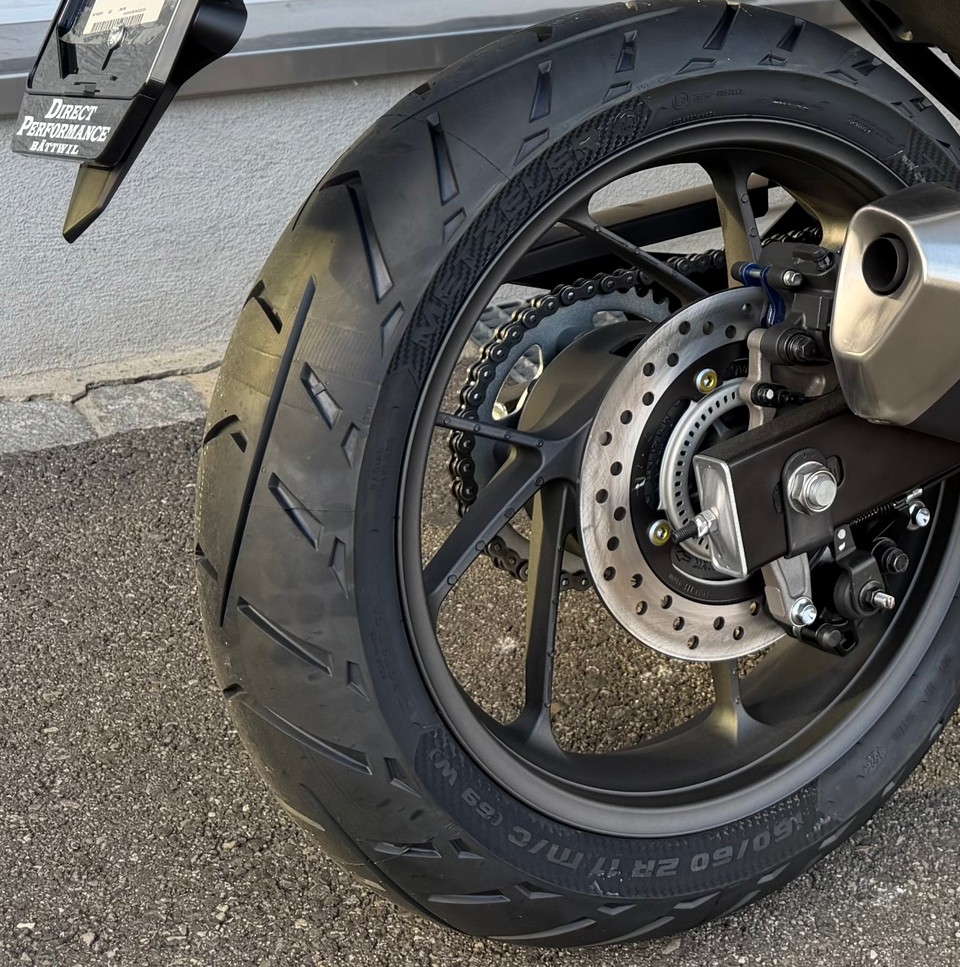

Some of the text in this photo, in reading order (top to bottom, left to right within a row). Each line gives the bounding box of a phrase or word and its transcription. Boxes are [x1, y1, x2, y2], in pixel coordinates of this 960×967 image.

[44, 98, 99, 121] DIRECT
[16, 115, 112, 142] PERFORMANCE
[29, 139, 80, 155] BÄTTWIL
